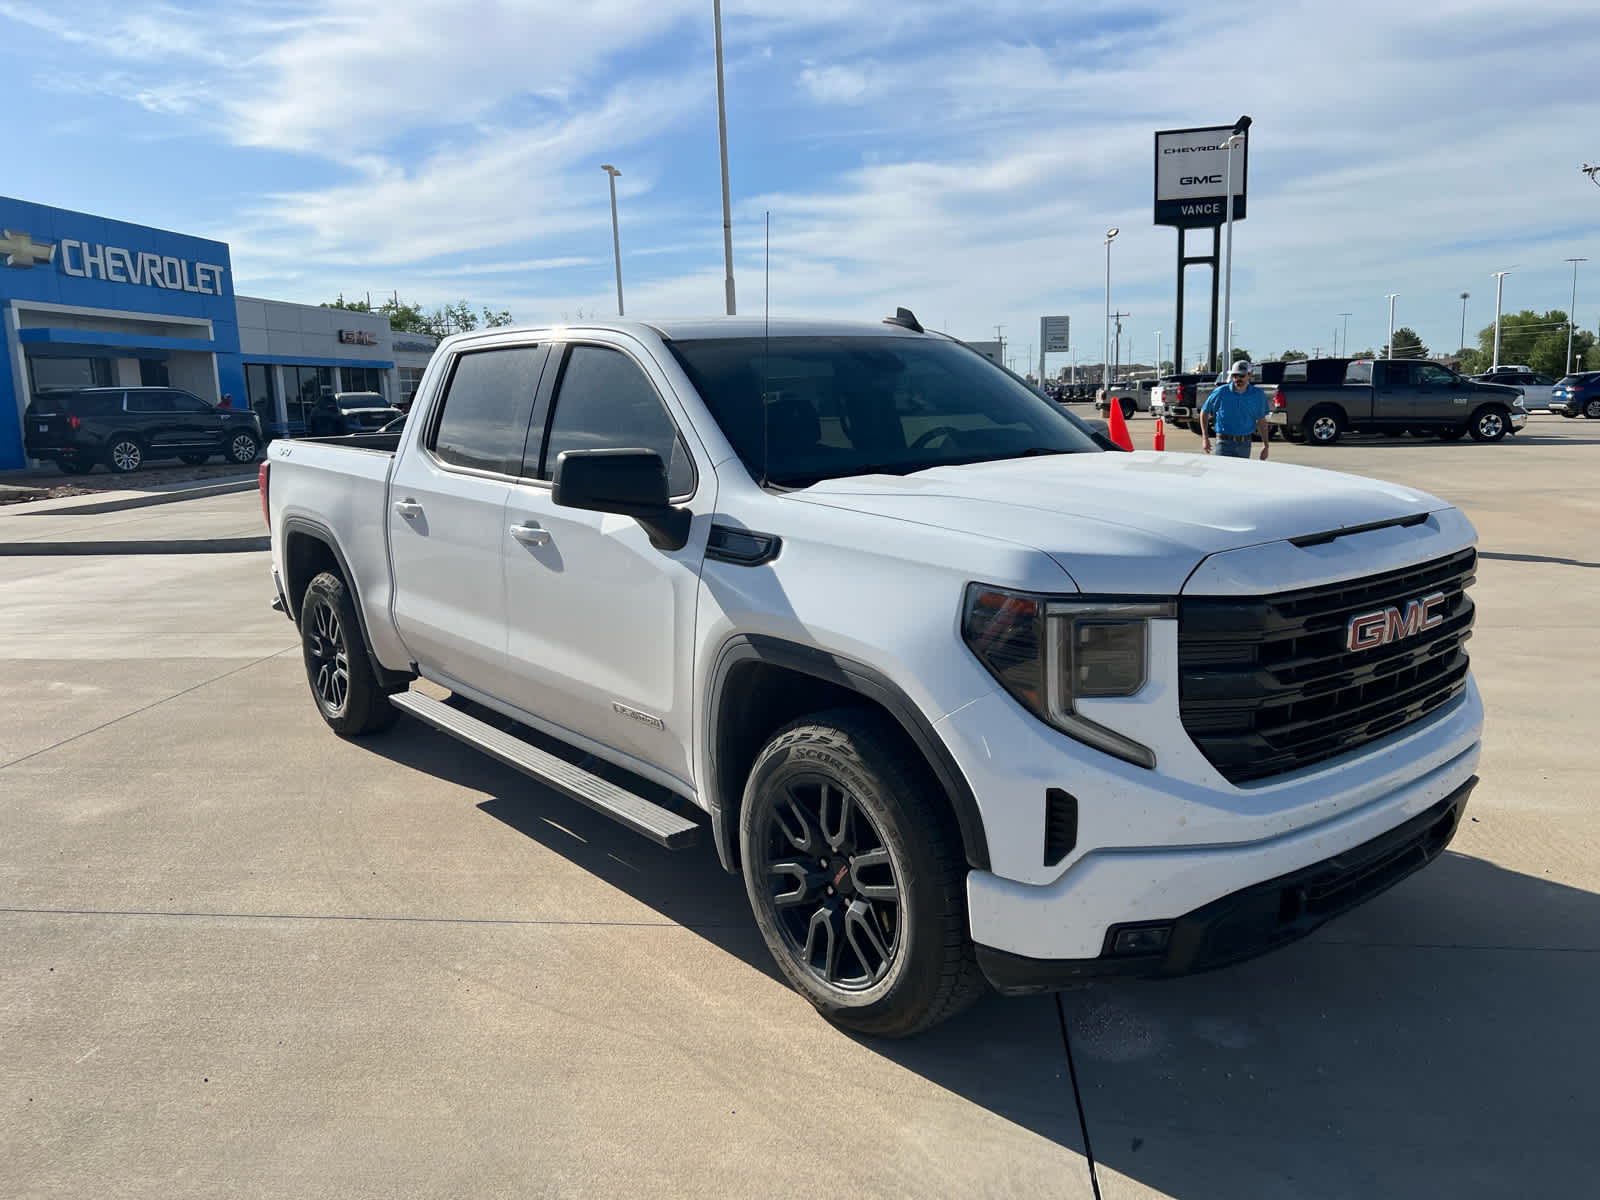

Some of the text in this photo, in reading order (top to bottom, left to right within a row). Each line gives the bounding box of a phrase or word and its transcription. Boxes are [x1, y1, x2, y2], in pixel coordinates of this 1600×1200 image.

[1163, 144, 1240, 155] CHEVROLT
[1179, 174, 1223, 186] GMC
[1181, 203, 1220, 216] VANCE
[61, 238, 224, 296] CHEVROLET
[1347, 591, 1445, 653] GMC
